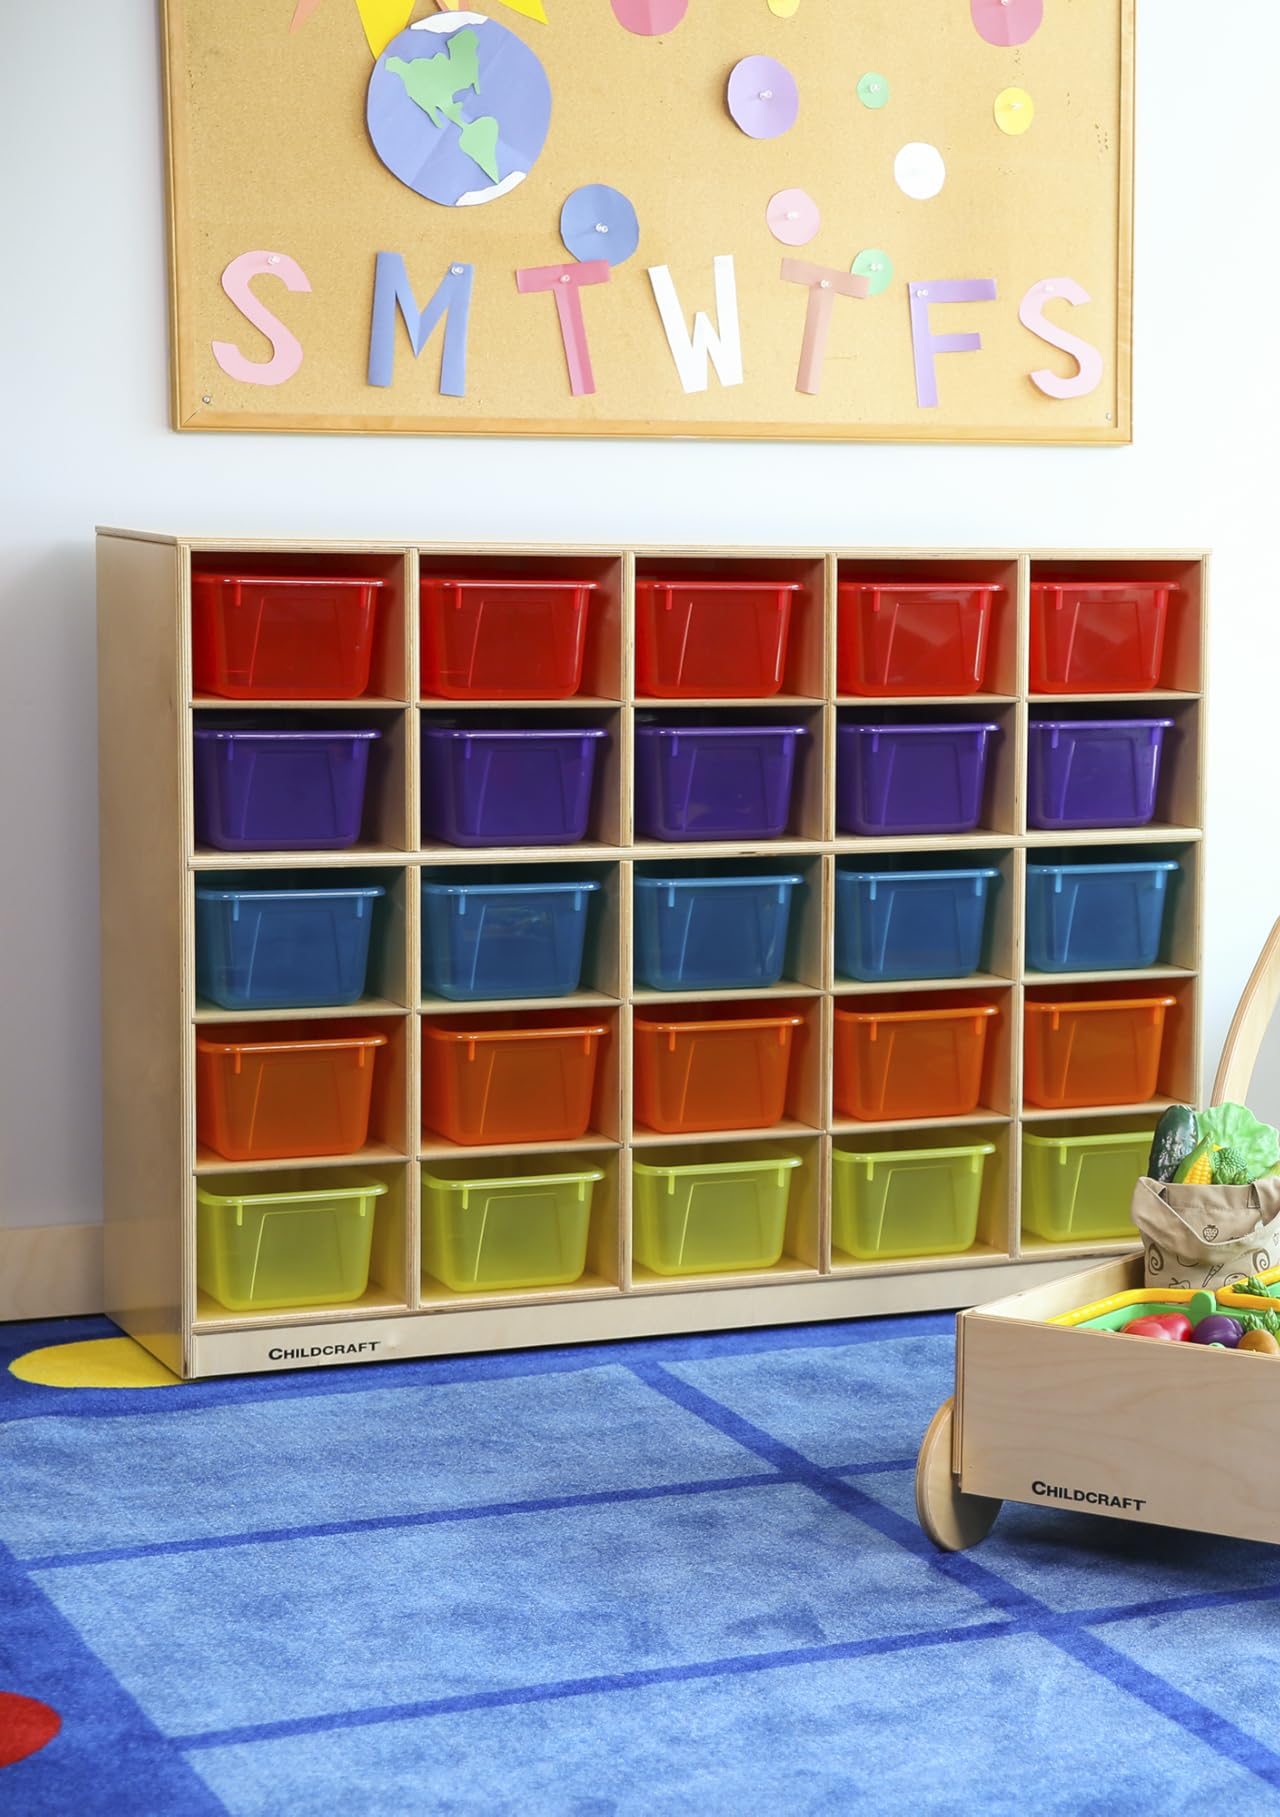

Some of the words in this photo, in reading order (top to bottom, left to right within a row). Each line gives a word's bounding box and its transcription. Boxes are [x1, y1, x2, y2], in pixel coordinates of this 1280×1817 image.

[212, 250, 312, 386] S
[366, 251, 474, 397] M
[516, 259, 611, 396] T
[648, 254, 744, 394] W
[780, 257, 871, 396] T
[909, 278, 997, 408] F
[1019, 277, 1103, 400] S
[268, 1341, 381, 1361] CHILDCRAFT
[1031, 1480, 1146, 1511] CHILDCRAFT
